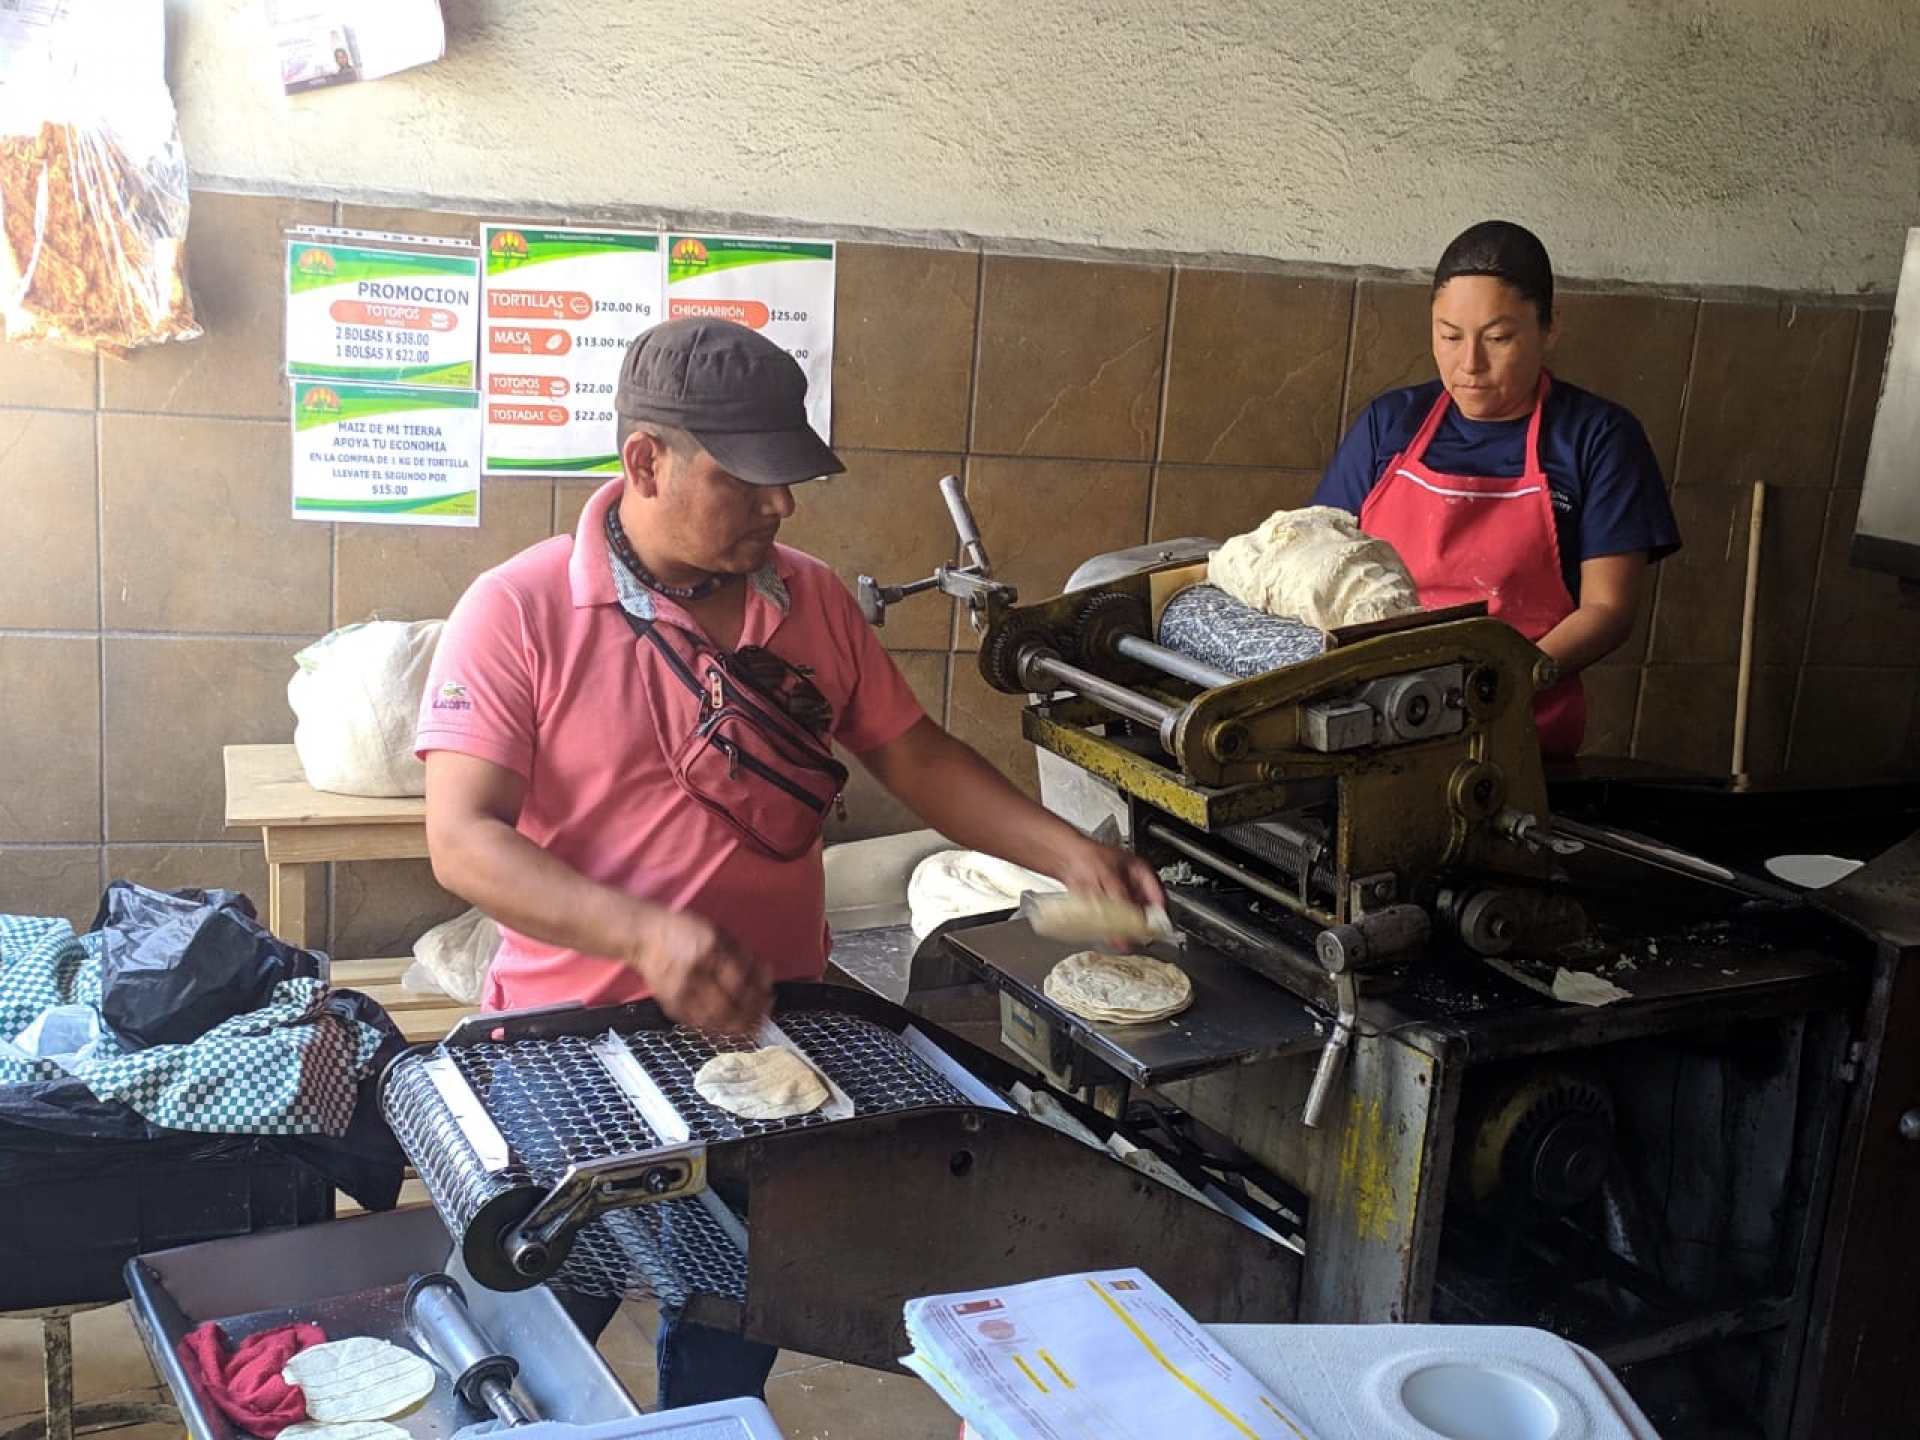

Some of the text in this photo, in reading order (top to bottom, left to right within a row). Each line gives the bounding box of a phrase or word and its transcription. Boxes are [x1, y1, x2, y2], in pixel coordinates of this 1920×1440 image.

[358, 281, 469, 306] PROMOCION
[365, 304, 420, 319] TOTOPOS
[491, 293, 651, 315] TORTILLAS $20.00 Kg
[770, 309, 808, 322] $25.00
[335, 326, 342, 339] 2
[345, 327, 383, 342] BOLSAS
[386, 332, 392, 344] X
[494, 330, 532, 345] MASA
[576, 336, 614, 348] $13.00
[336, 345, 430, 363] 1 BOLSAS X $22.00
[493, 377, 613, 394] TOTOPOS $22.00
[492, 408, 613, 421] TOSTADAS $22.00
[338, 421, 442, 437] MAIZ DE MI TIERRA
[333, 437, 447, 452] APOYA TU ECONOMIA
[309, 452, 322, 462] EN
[324, 453, 335, 462] LA
[338, 454, 374, 464] COMPRA
[377, 455, 388, 464] DE
[398, 456, 411, 466] KG
[413, 456, 425, 466] DE
[427, 457, 469, 468] TORTILLA
[332, 468, 447, 482] LLEVATE EL SEGUNDO POR
[371, 484, 409, 496] $15.00
